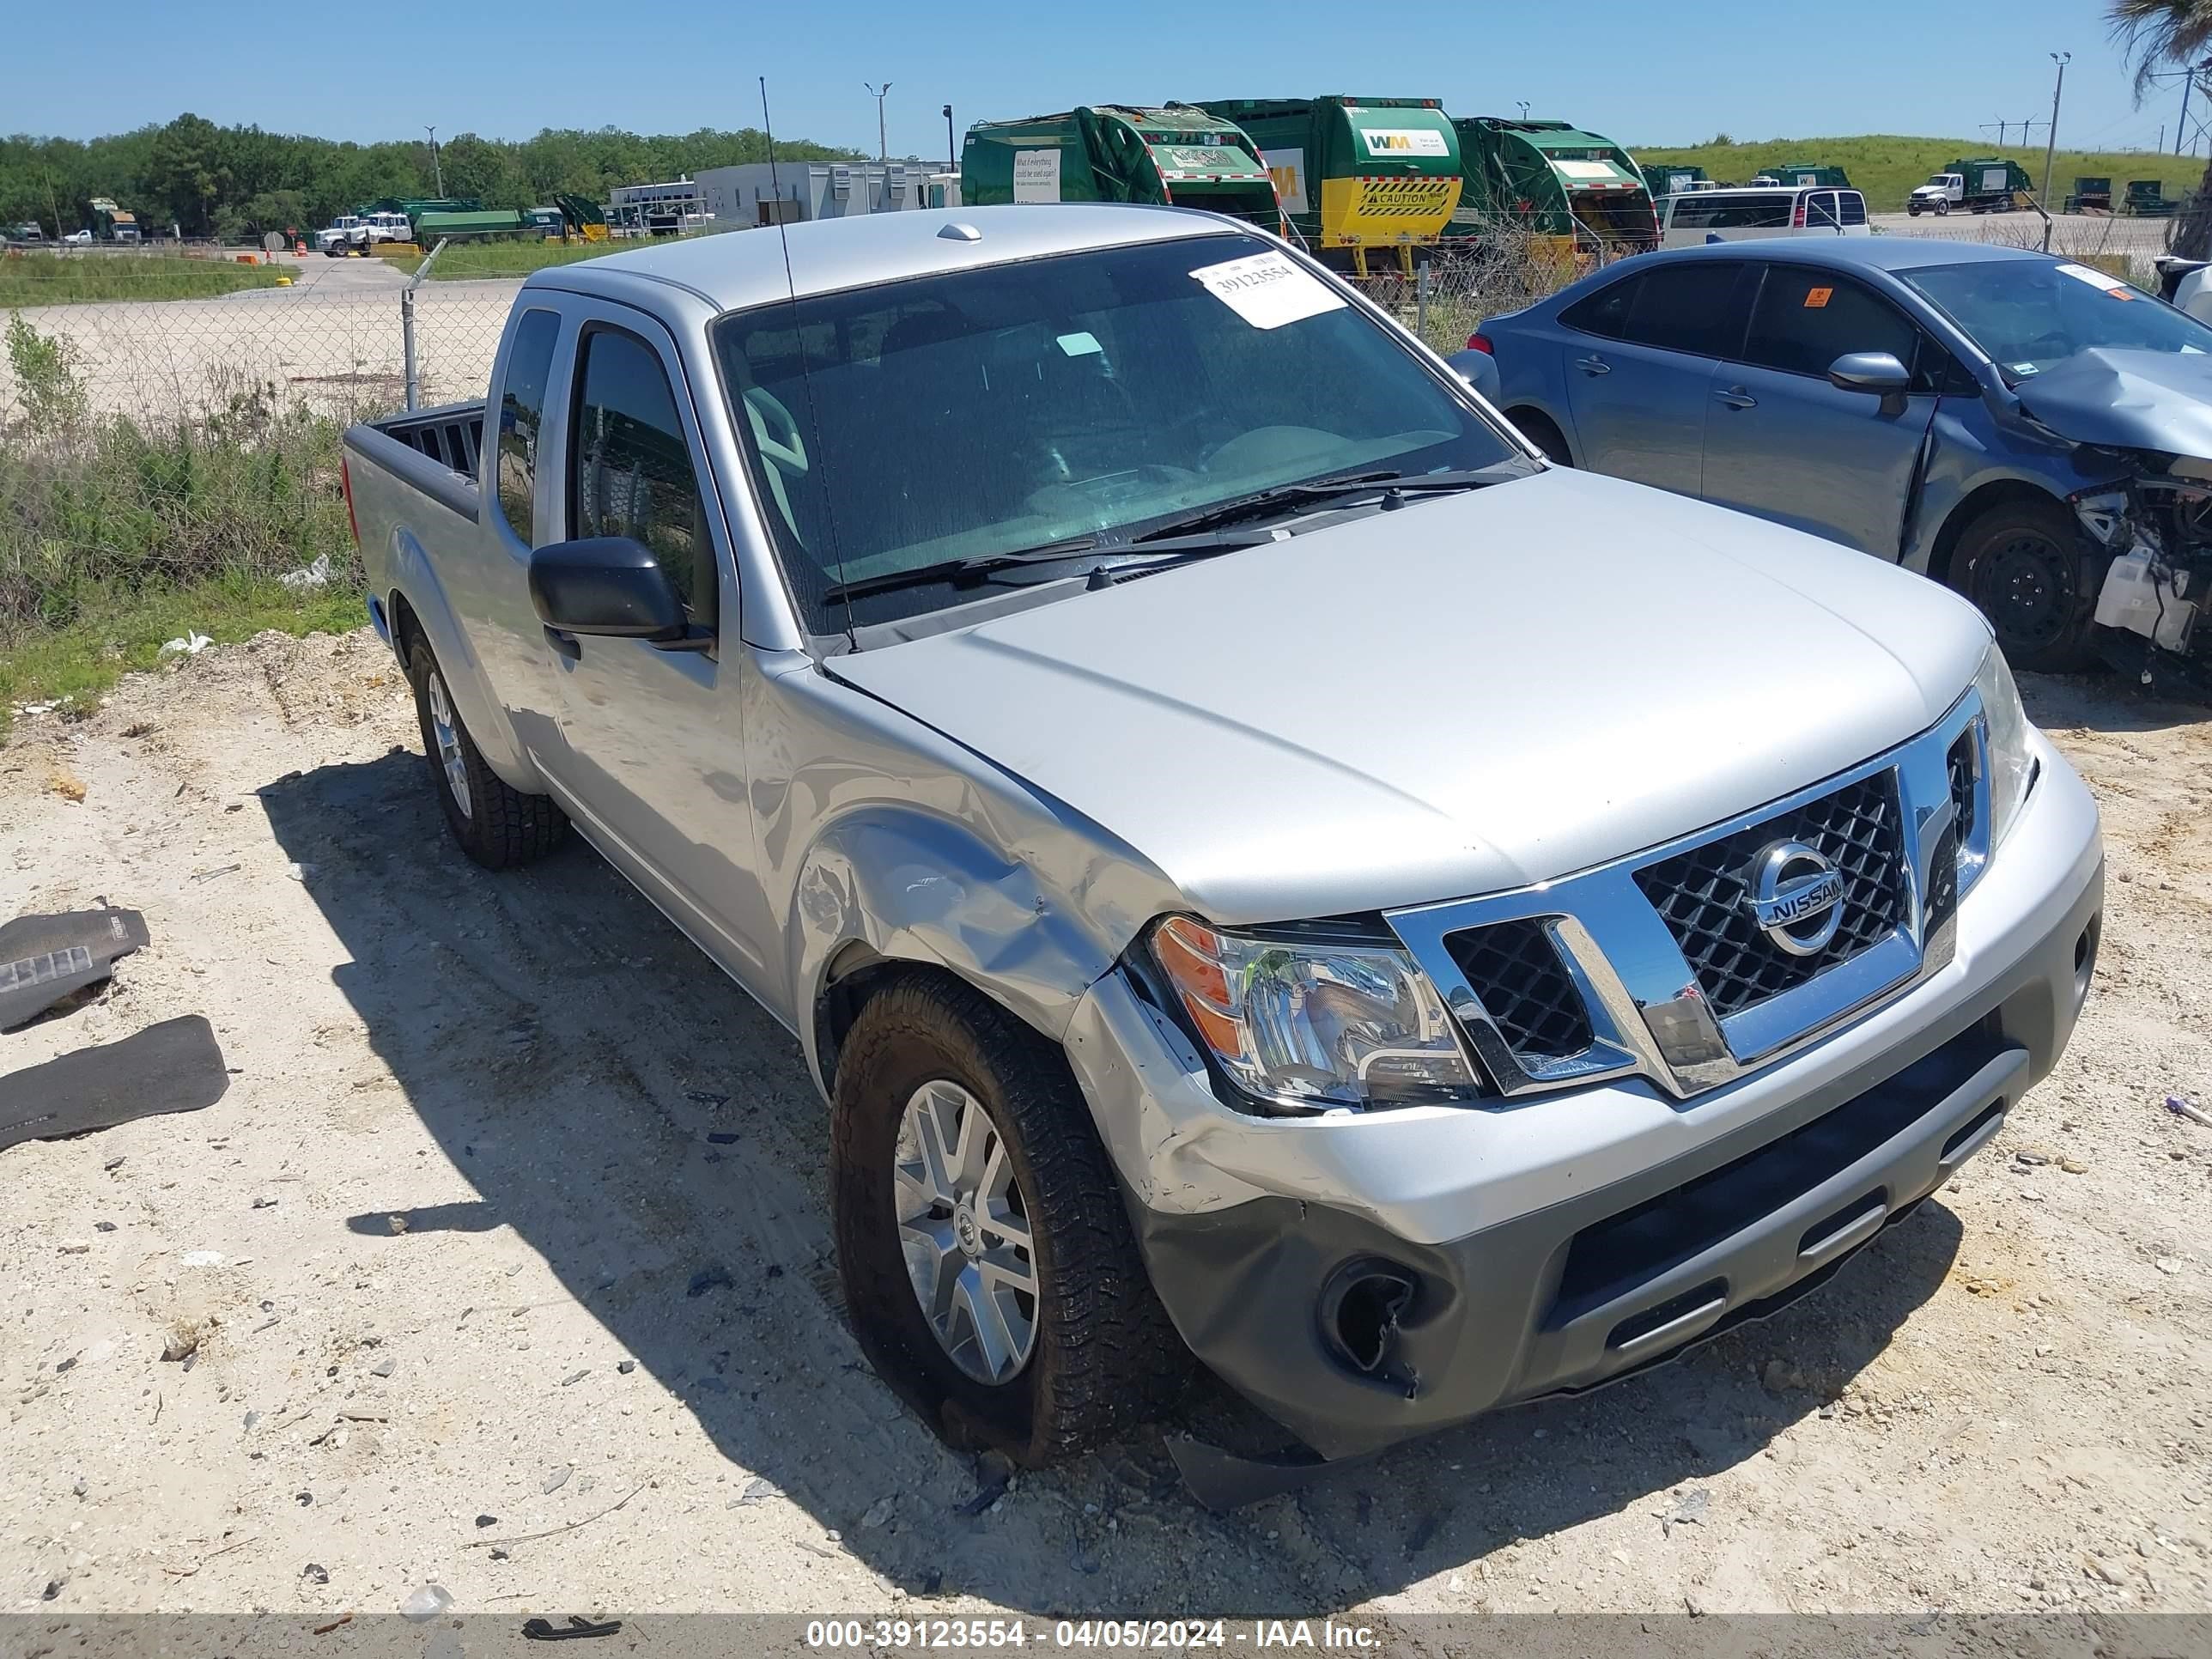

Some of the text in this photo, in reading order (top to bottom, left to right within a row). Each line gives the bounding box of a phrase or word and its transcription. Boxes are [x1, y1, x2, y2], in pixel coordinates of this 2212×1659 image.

[1370, 136, 1412, 149] WM
[1380, 193, 1426, 203] CAUTION
[1216, 265, 1294, 294] 39123554
[1772, 878, 1843, 921] NISSAN
